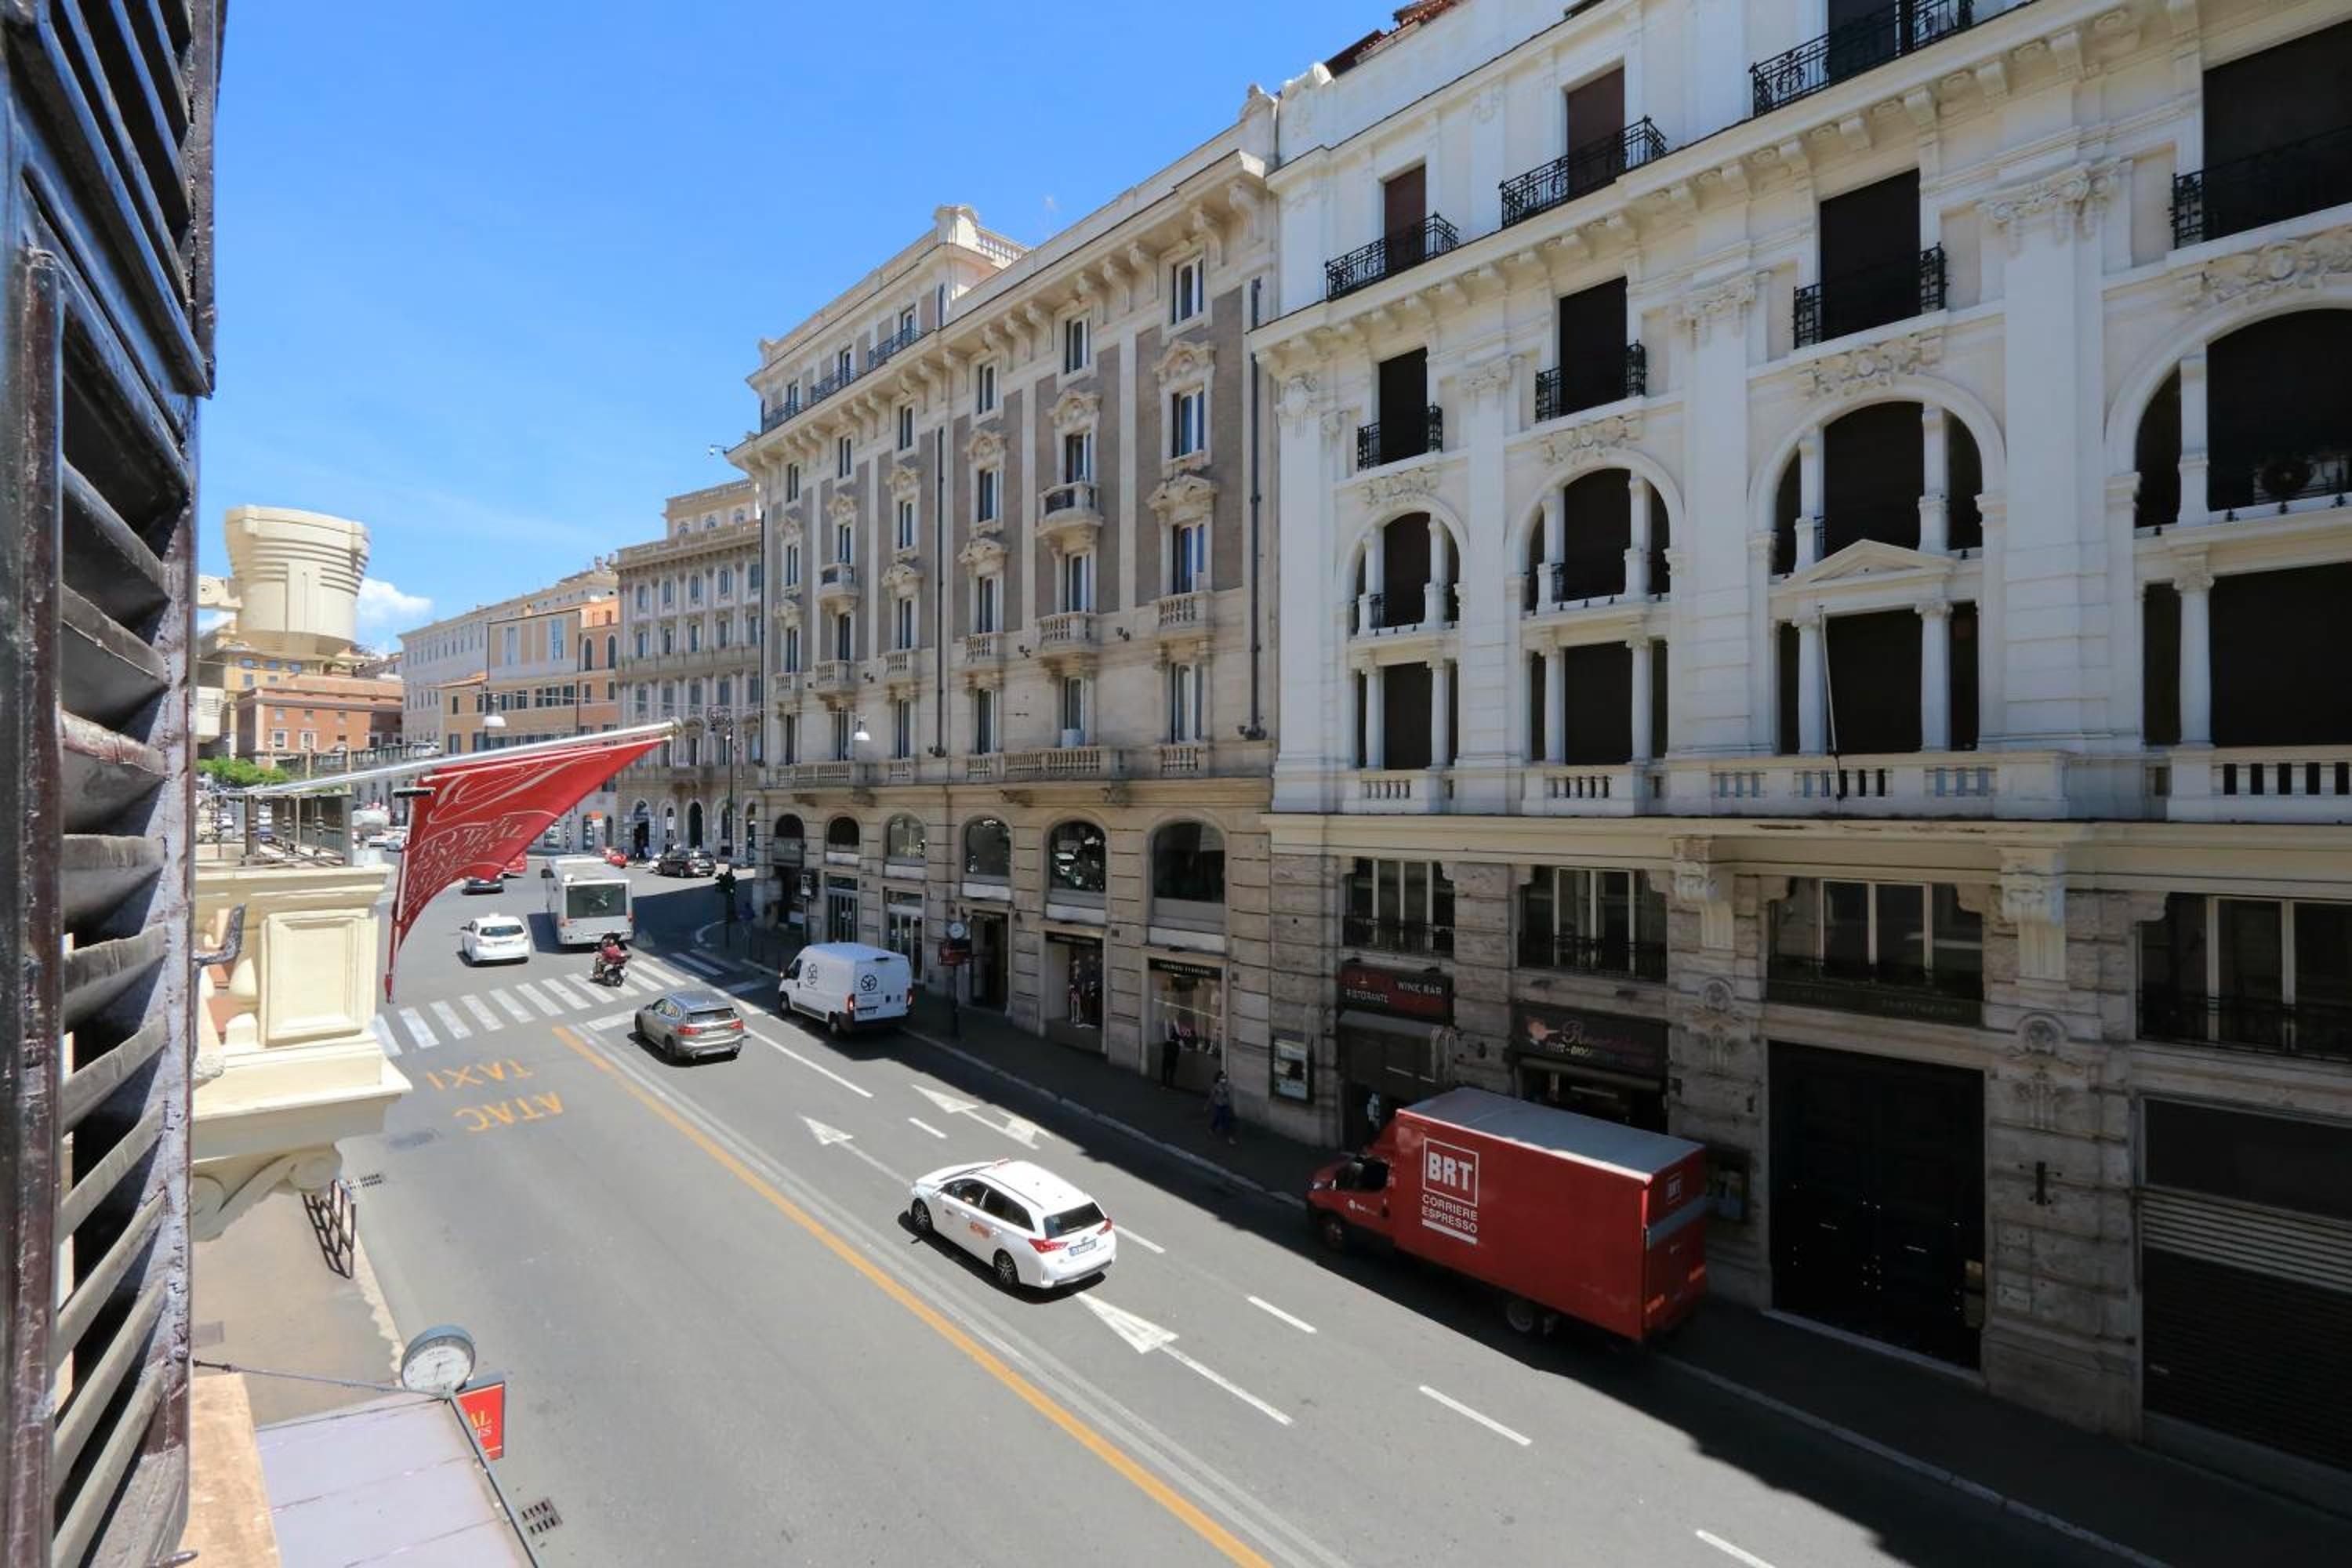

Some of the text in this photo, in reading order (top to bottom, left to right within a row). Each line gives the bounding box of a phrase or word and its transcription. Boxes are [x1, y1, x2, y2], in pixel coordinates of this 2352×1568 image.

[1422, 984, 1443, 996] BAR
[426, 1058, 535, 1091] TAXI
[452, 1091, 564, 1132] ATAC
[1428, 1152, 1473, 1191] BRT
[1421, 1206, 1478, 1233] ESPRESSO
[1422, 1194, 1478, 1221] CORRIERE
